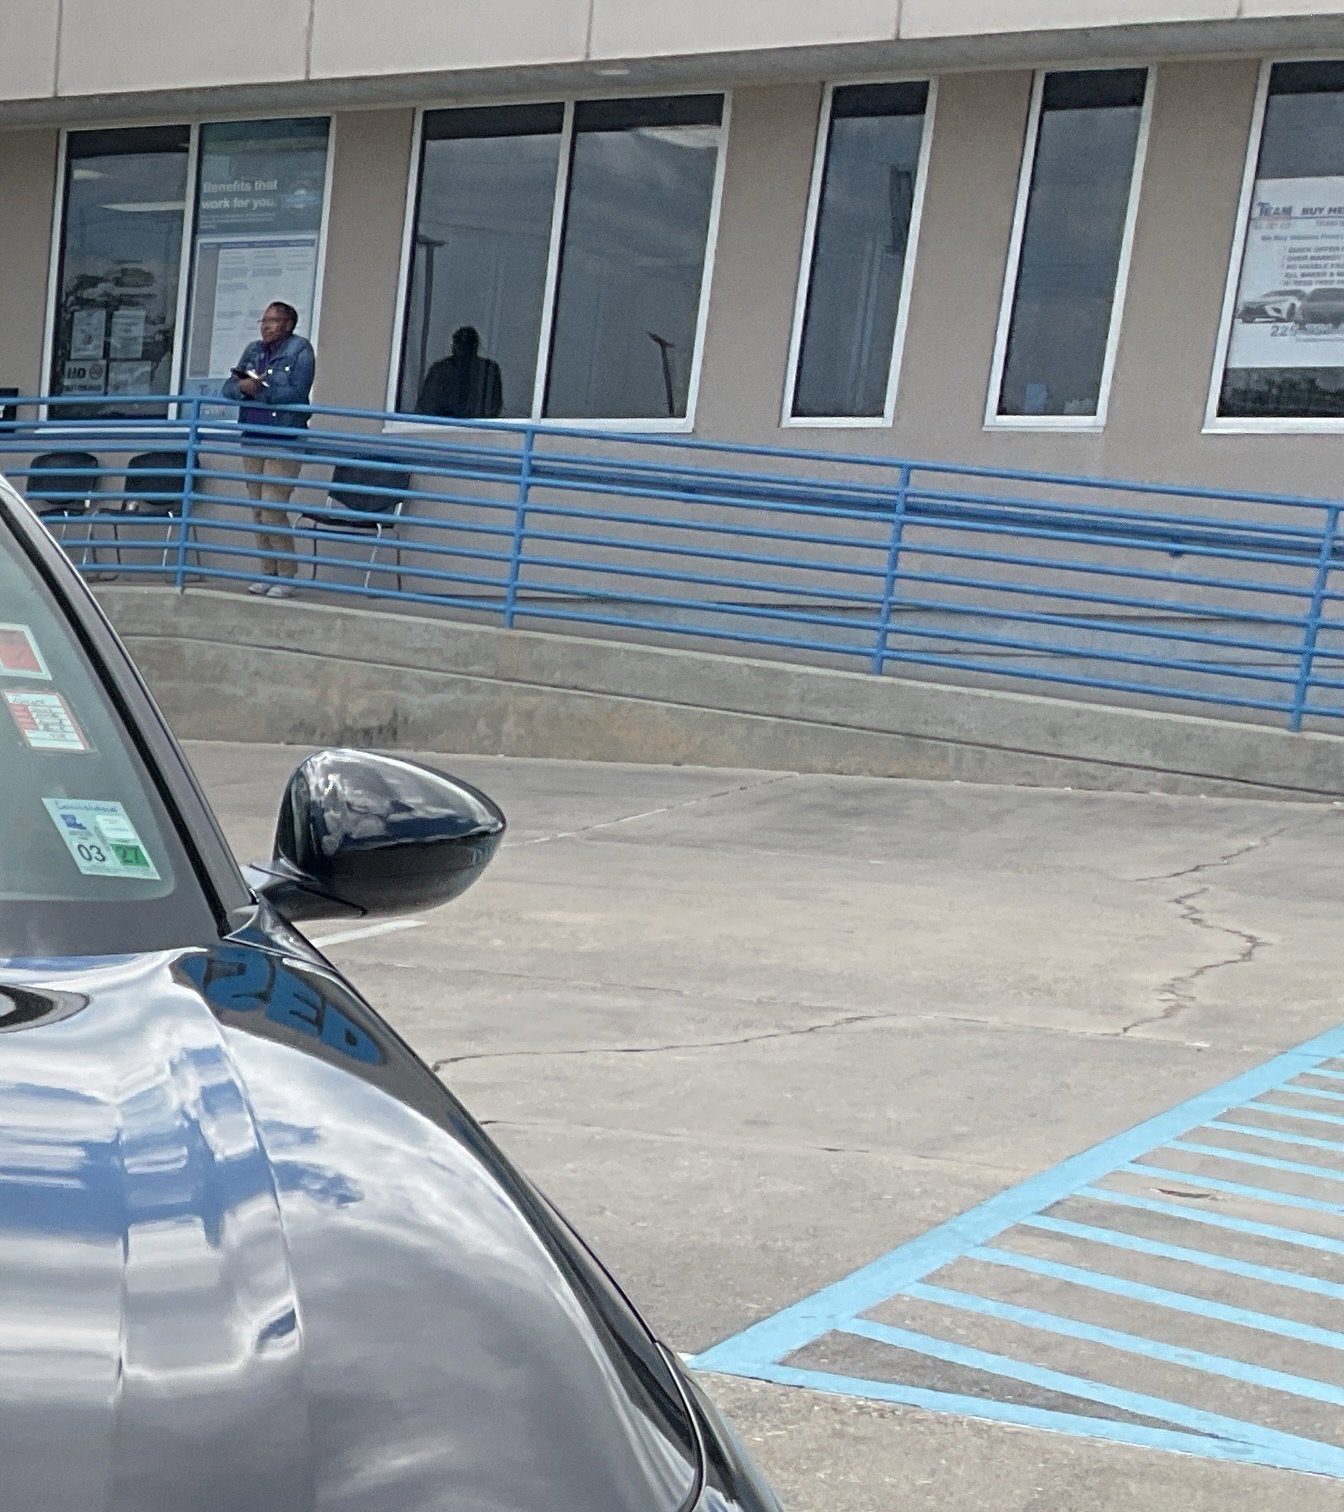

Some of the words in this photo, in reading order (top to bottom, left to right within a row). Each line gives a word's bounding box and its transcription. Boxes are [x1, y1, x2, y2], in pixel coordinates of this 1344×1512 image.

[203, 181, 251, 192] Benefits
[254, 180, 278, 191] that
[201, 197, 230, 209] work
[233, 197, 249, 208] for
[77, 844, 106, 862] 03
